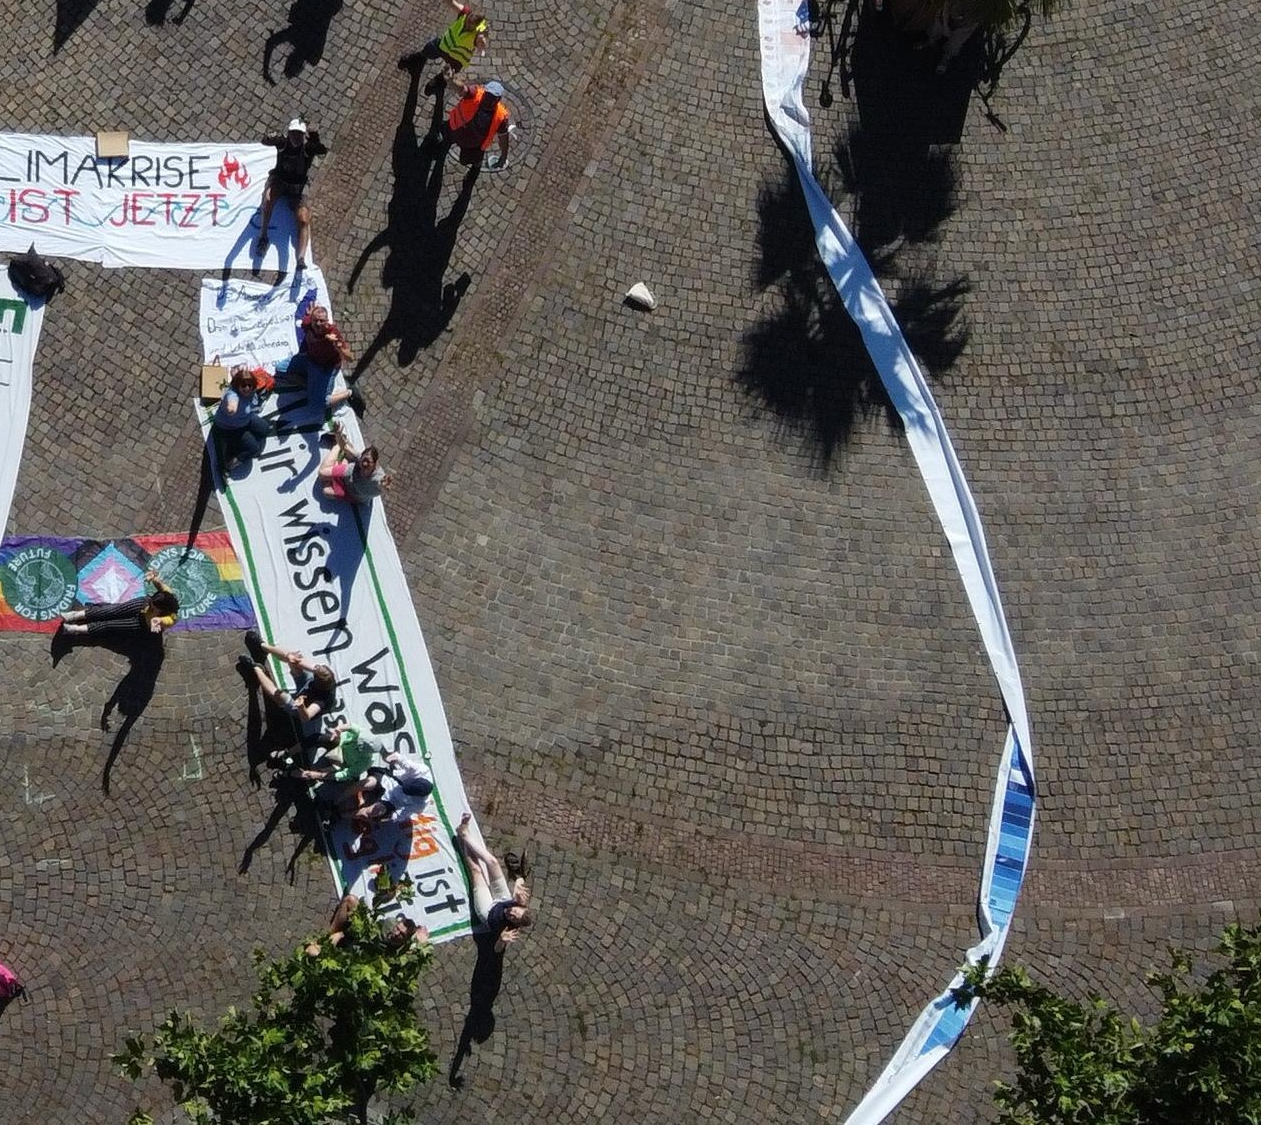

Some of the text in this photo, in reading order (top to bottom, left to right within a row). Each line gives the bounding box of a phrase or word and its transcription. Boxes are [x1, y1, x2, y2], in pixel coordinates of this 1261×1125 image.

[9, 187, 227, 229] IST JETZT
[6, 547, 52, 573] FUTURE
[13, 601, 35, 619] FOR
[277, 498, 353, 656] wissen
[415, 867, 466, 914] ist
